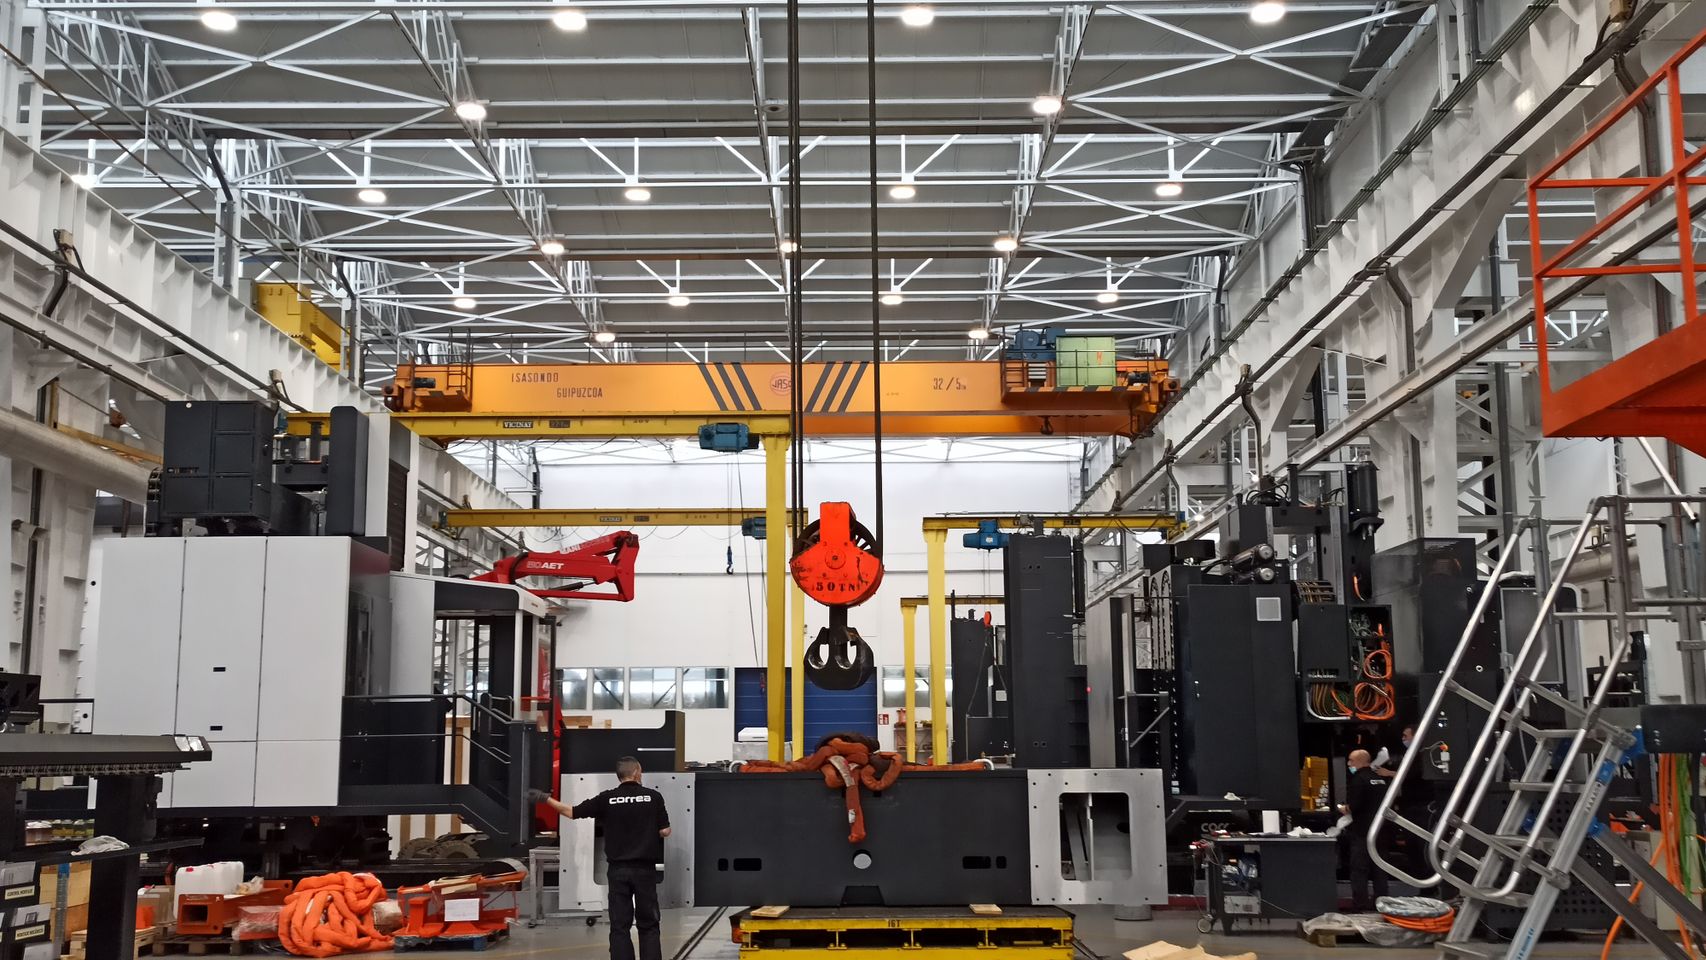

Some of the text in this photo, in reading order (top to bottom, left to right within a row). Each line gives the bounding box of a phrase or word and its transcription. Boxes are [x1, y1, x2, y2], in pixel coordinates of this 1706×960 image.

[511, 372, 559, 383] ISASONDO
[556, 387, 603, 398] GUIPUZCOA
[608, 795, 652, 805] correa
